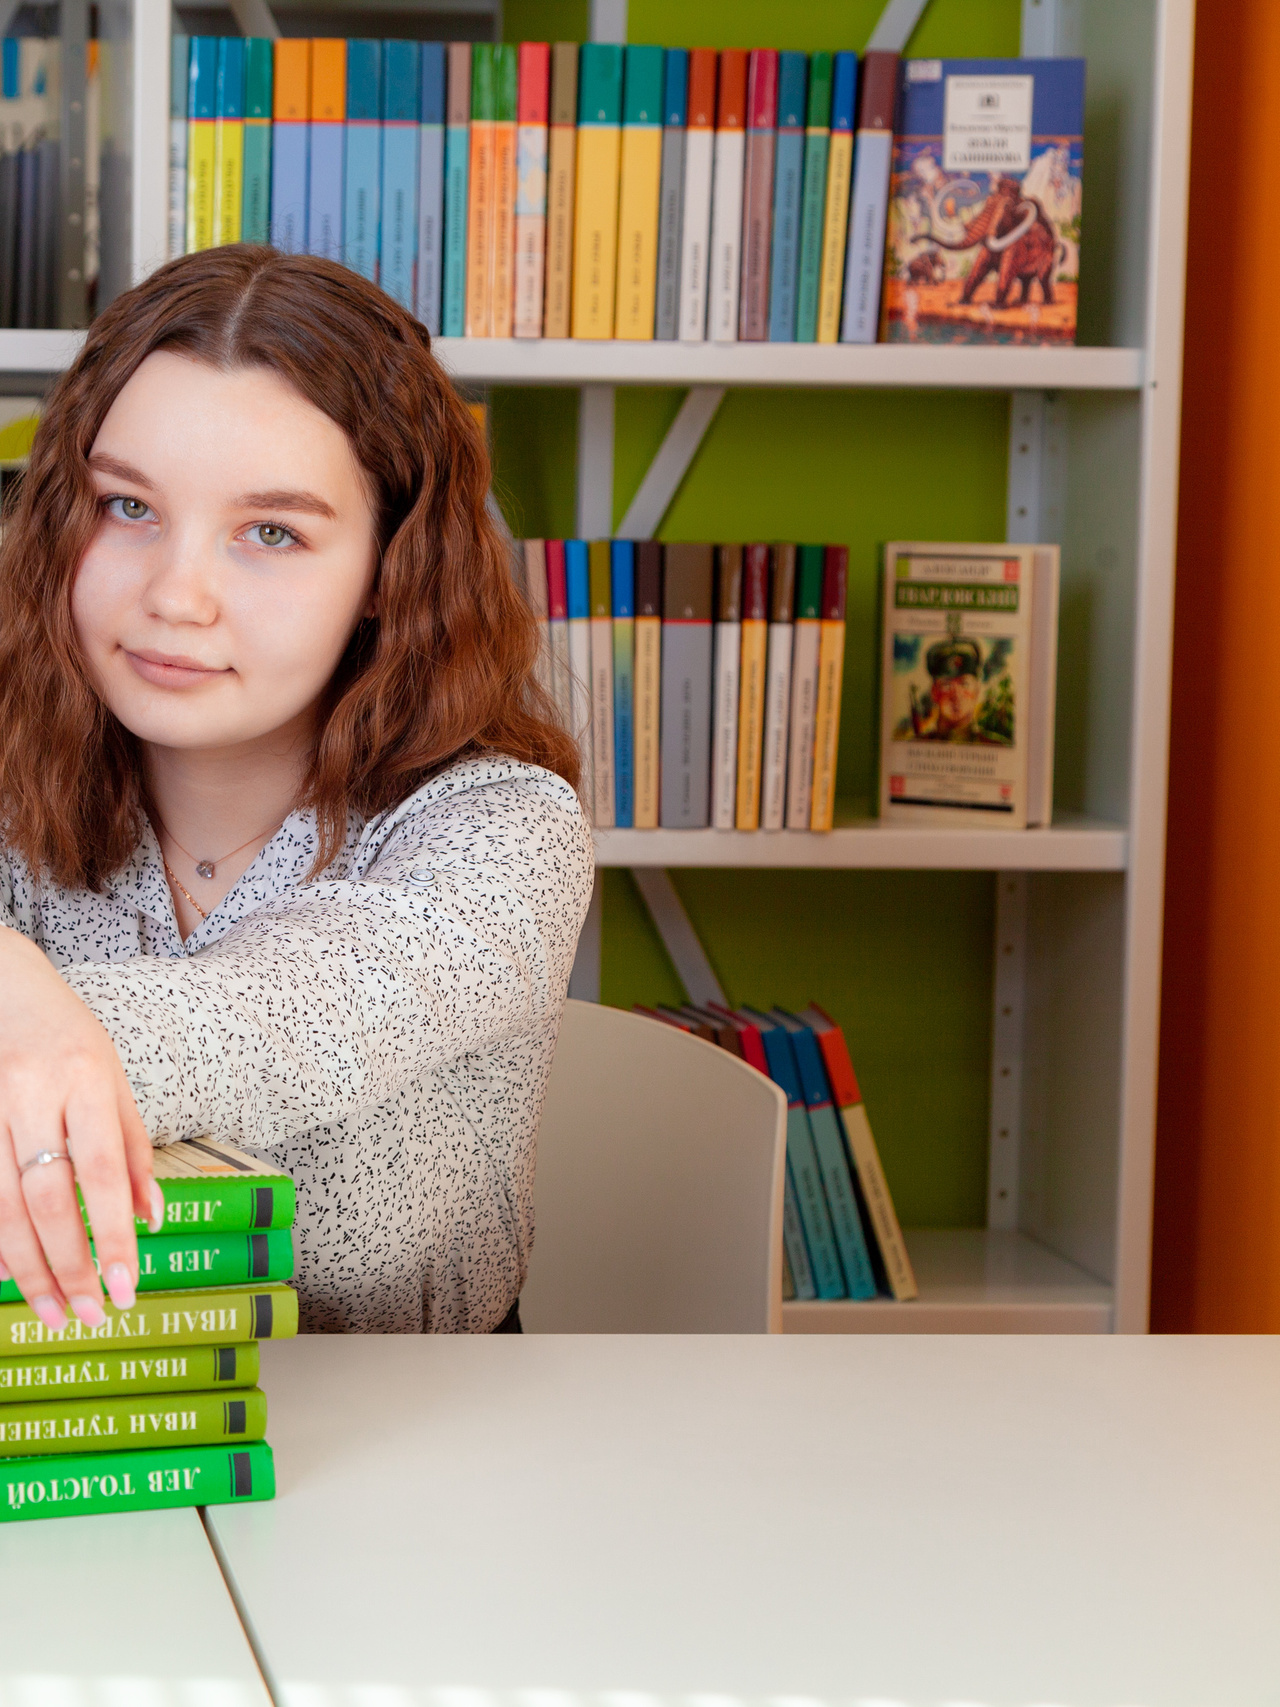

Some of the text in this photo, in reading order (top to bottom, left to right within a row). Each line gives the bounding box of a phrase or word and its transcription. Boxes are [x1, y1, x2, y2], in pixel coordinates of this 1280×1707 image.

[167, 1200, 222, 1222] ЛЕВ
[168, 1248, 220, 1272] ЛЕВ
[161, 1308, 238, 1335] ИВАН
[120, 1357, 188, 1381] ИВАН
[129, 1411, 197, 1434] ИВАН
[7, 1466, 201, 1510] ЛЕВ ТОЛСТОЙ
